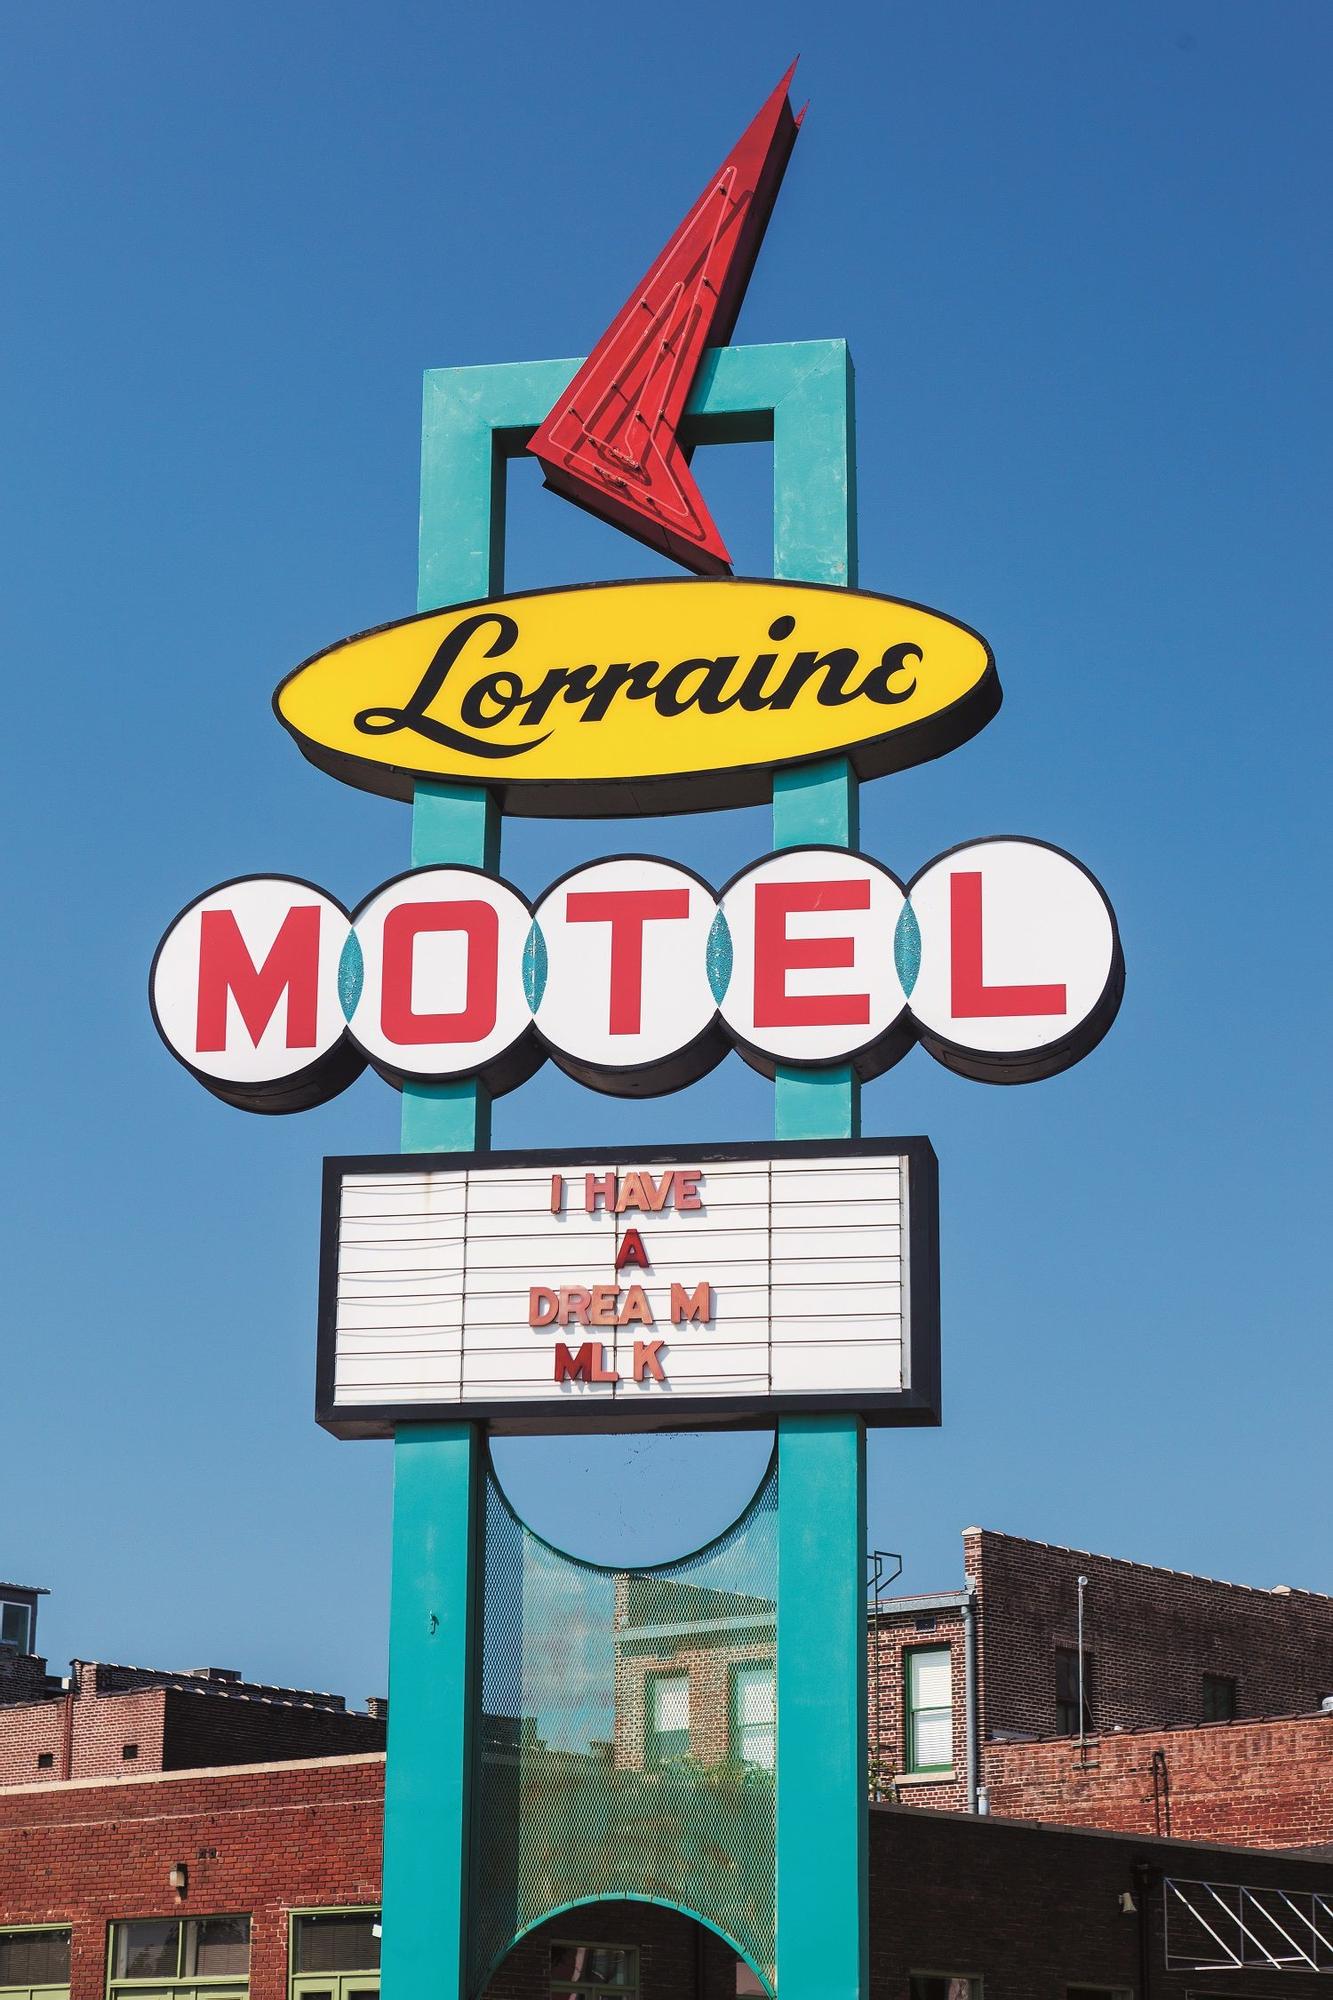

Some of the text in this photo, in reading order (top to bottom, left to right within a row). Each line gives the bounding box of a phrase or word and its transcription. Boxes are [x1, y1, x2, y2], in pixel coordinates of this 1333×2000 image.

[353, 613, 923, 758] Lorraine
[195, 871, 1067, 1053] MOTEL
[551, 1170, 702, 1214] I HAVE
[614, 1228, 649, 1269] A
